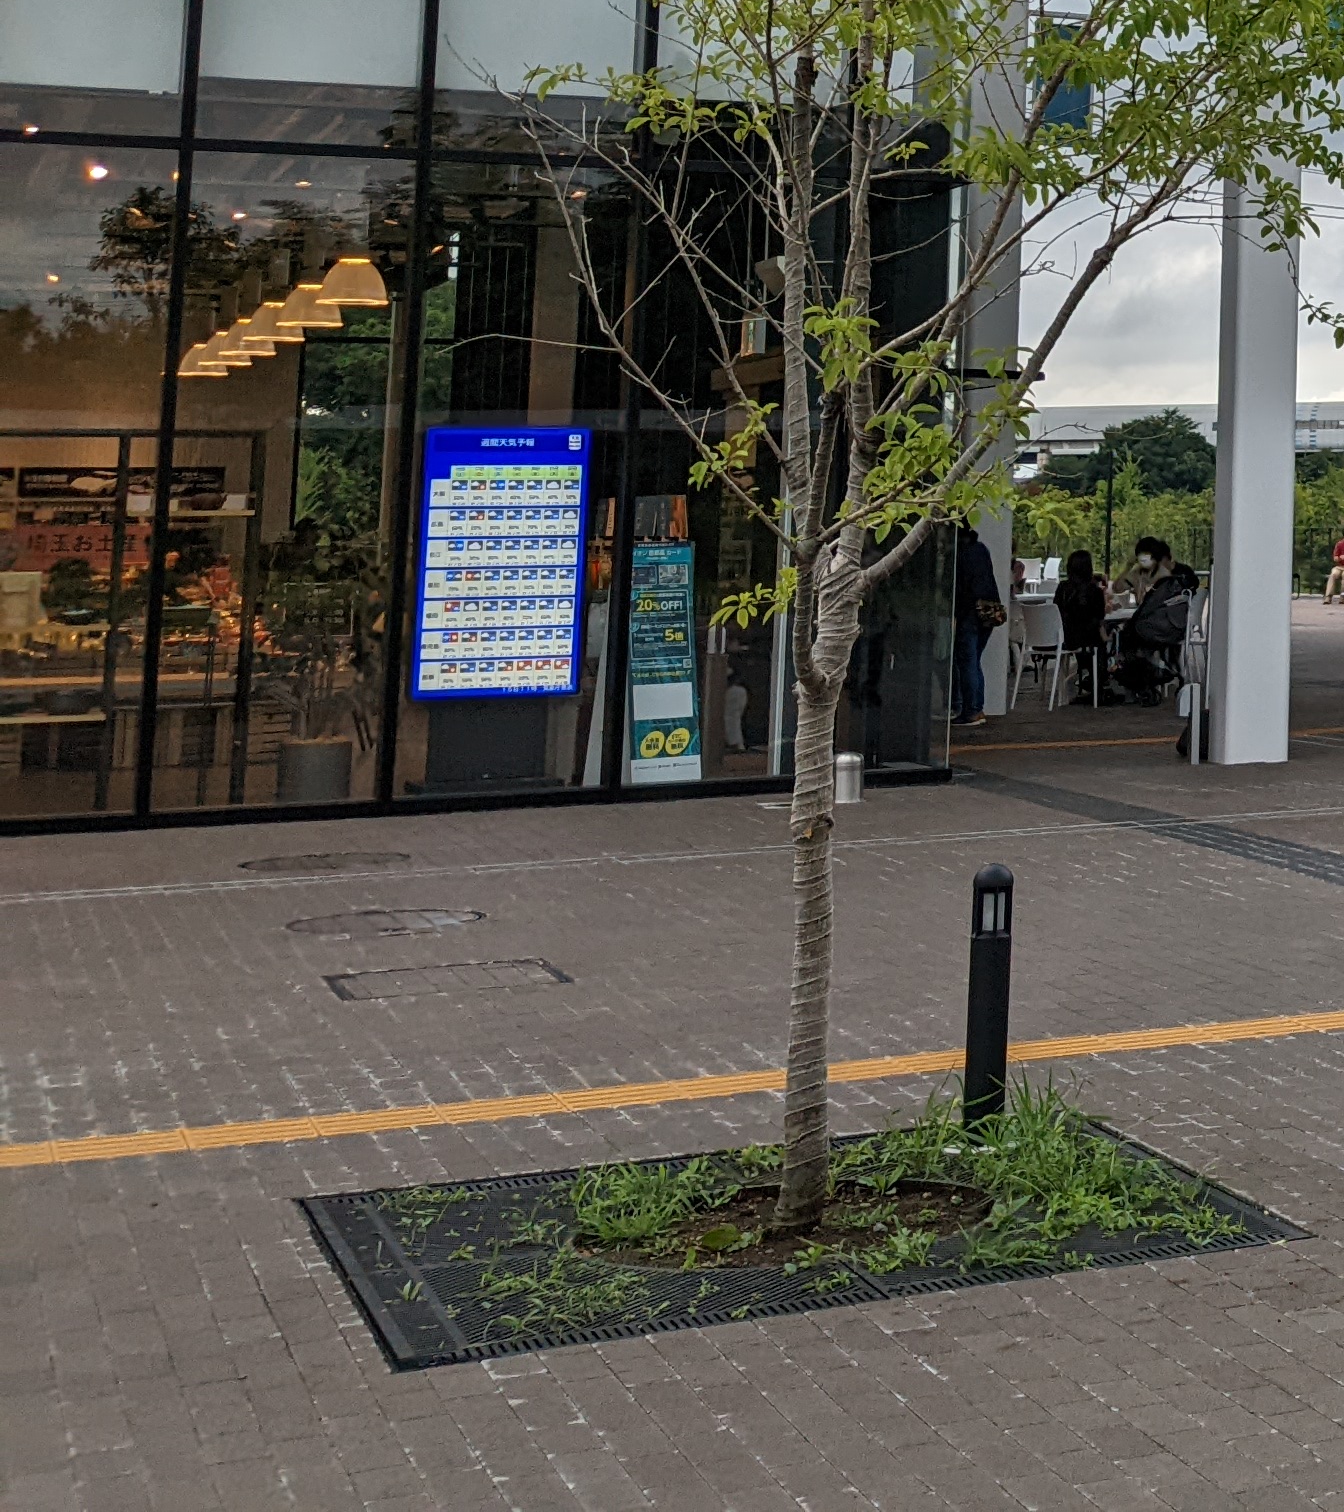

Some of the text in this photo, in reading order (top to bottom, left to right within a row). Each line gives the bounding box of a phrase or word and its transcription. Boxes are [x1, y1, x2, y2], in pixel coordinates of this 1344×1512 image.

[480, 437, 535, 447] 週間天気予報
